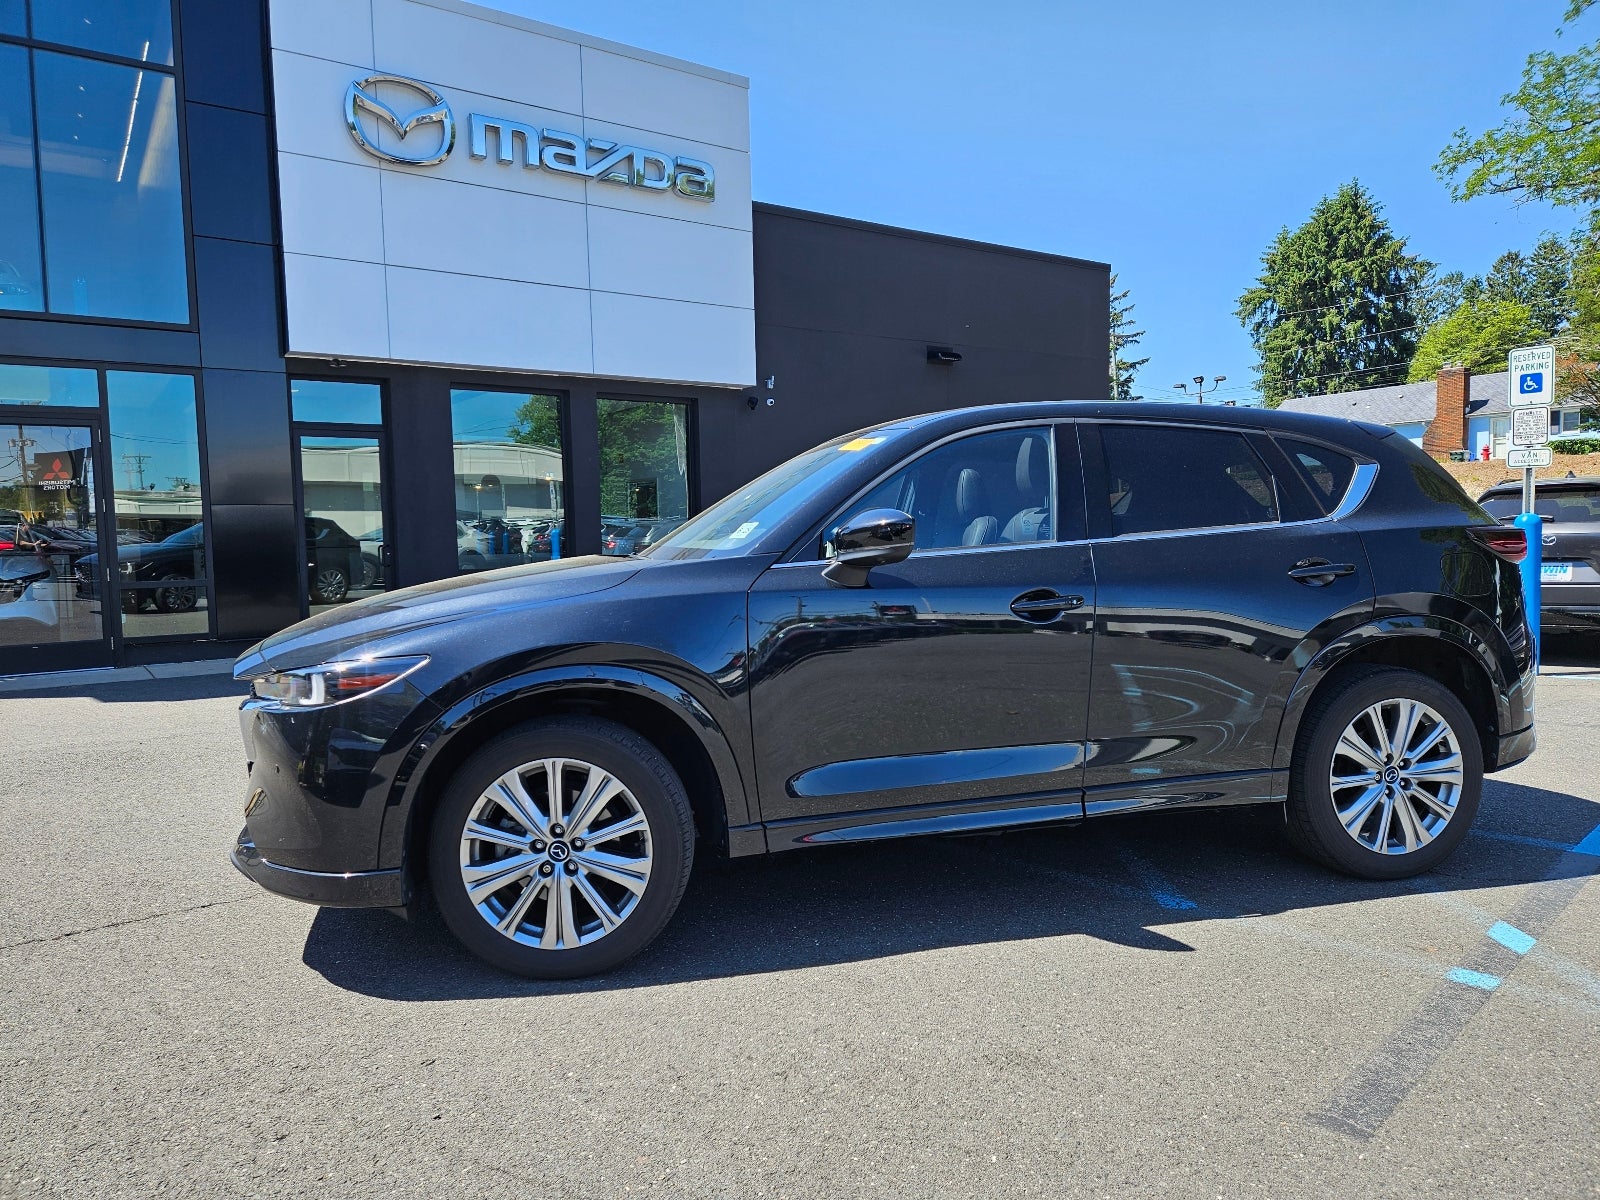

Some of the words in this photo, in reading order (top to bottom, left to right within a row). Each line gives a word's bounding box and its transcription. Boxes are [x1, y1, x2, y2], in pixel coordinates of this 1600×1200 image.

[1513, 351, 1551, 363] RESERVED
[1514, 362, 1549, 373] PARKING
[1521, 451, 1538, 459] VAN
